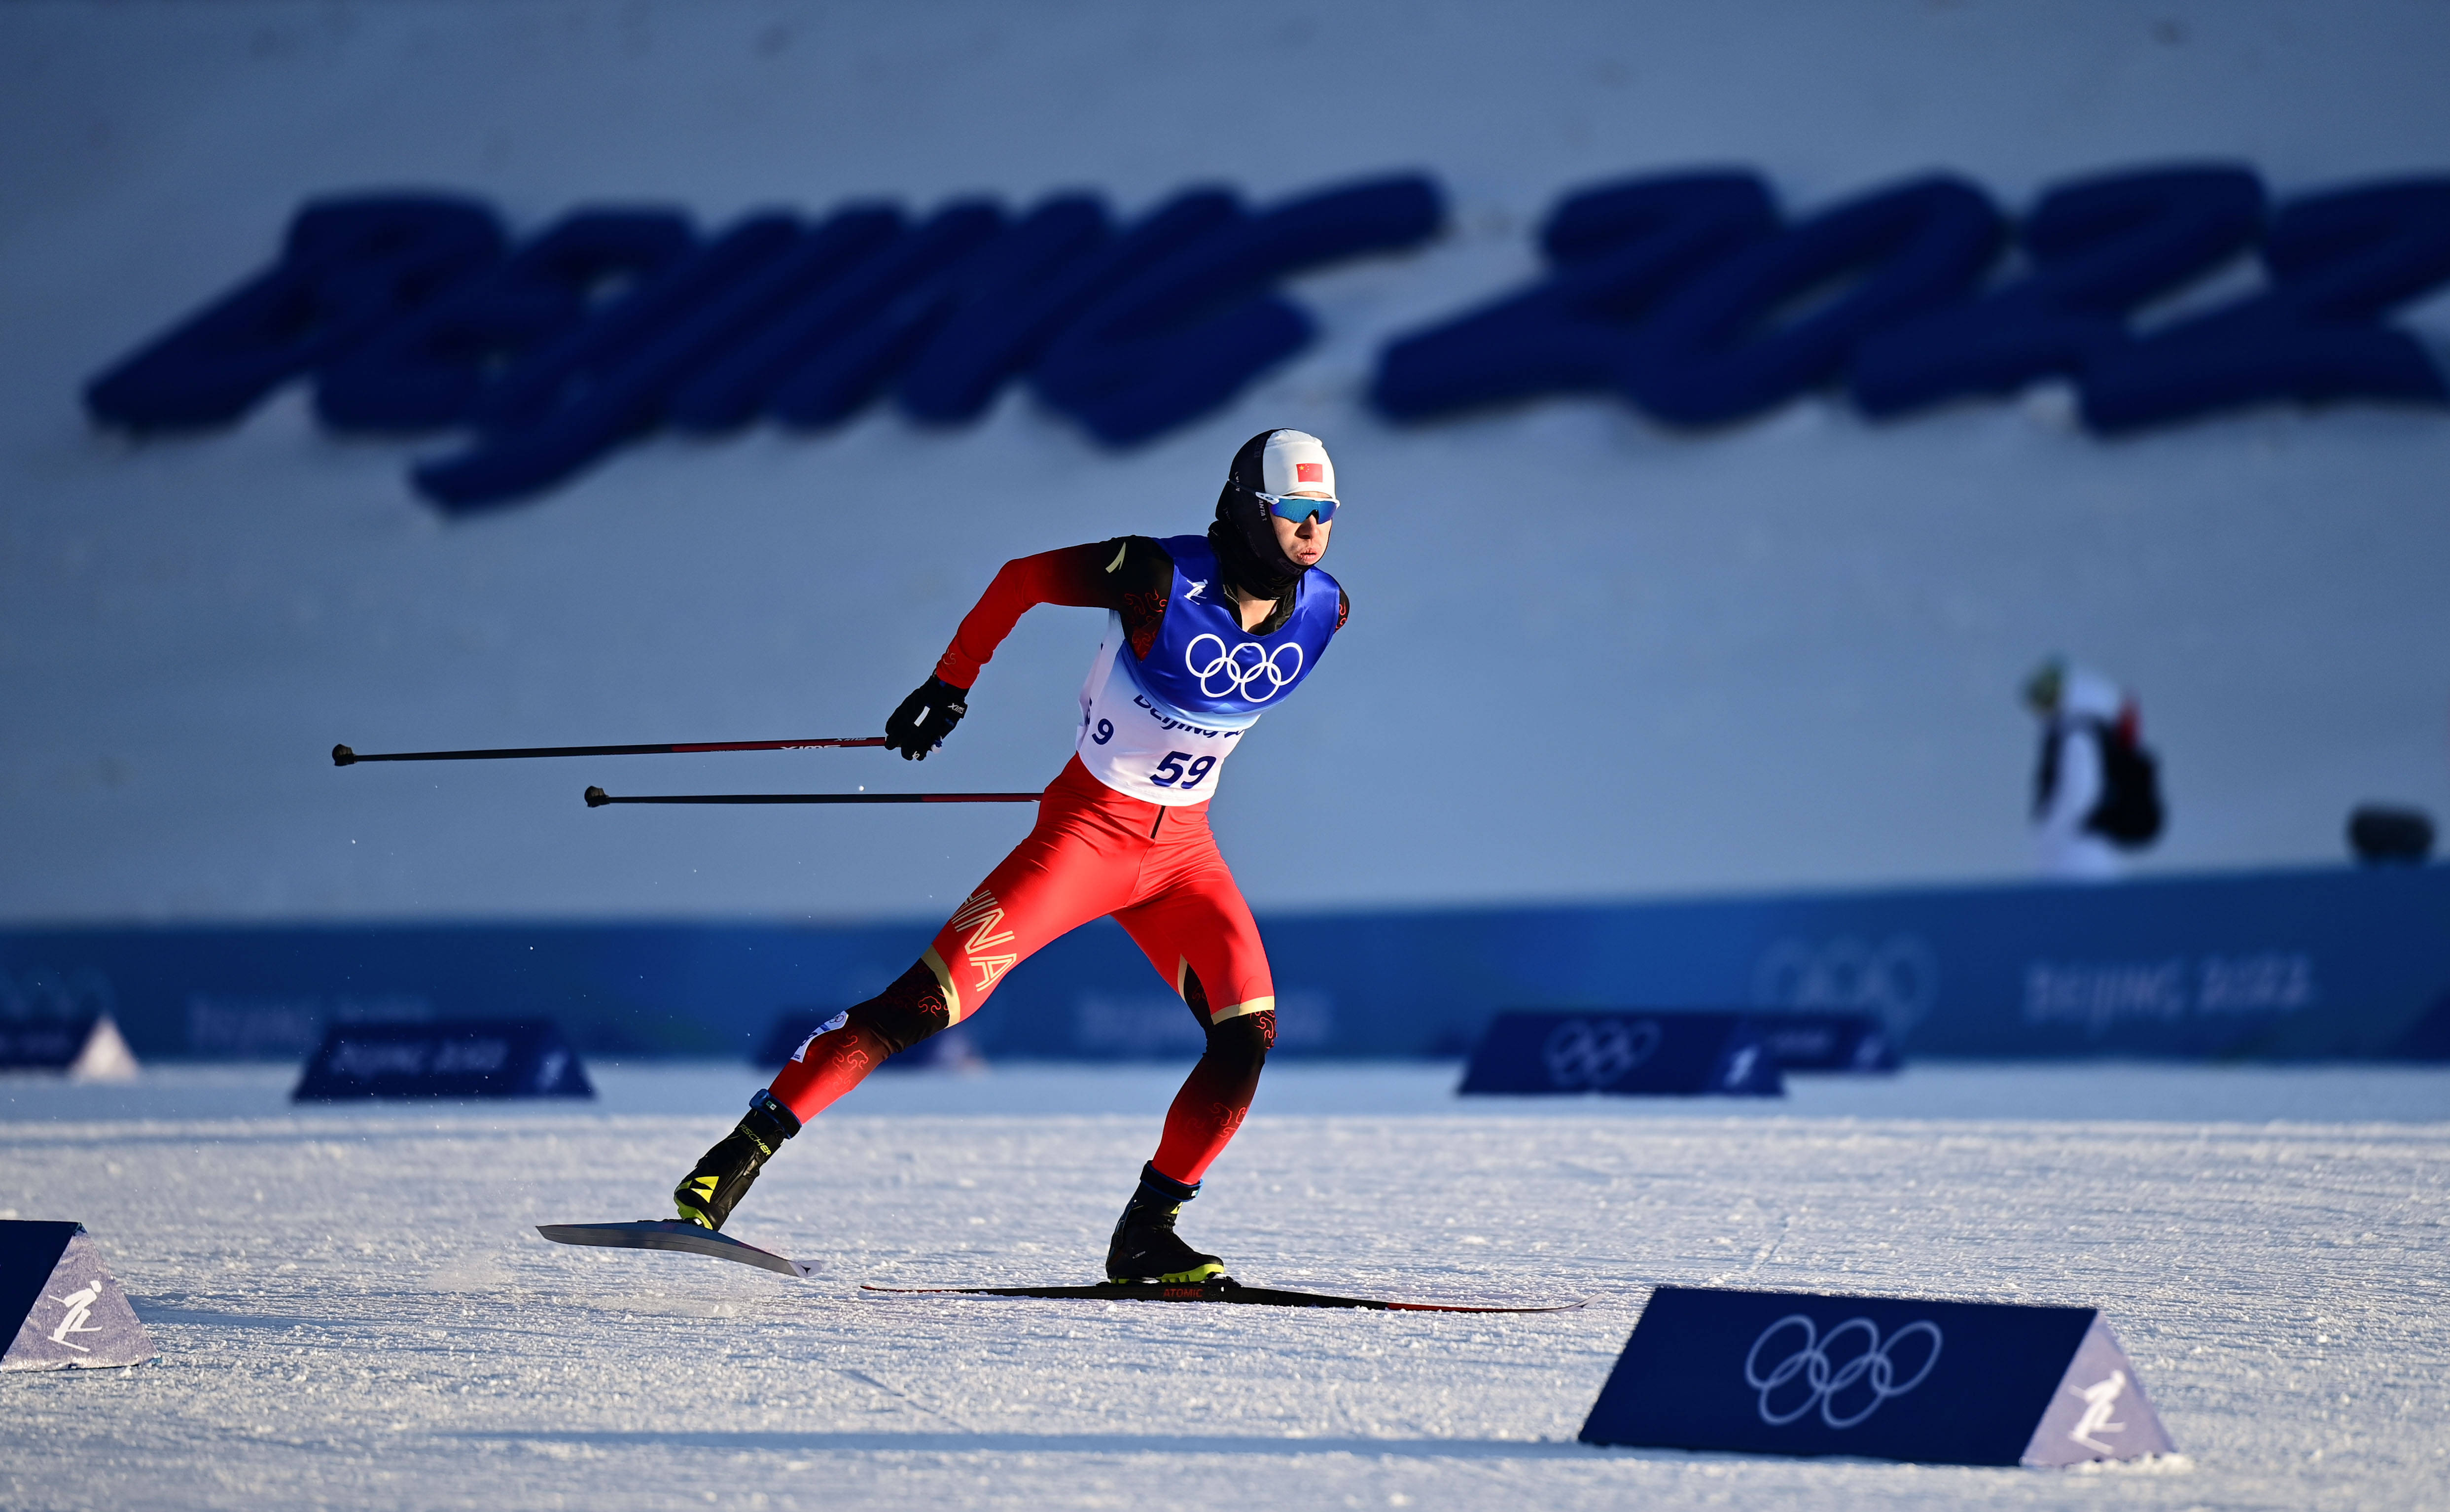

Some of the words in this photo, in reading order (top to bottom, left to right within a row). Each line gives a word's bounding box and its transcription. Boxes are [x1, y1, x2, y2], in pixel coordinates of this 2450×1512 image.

[1366, 160, 2450, 436] 2022
[1150, 751, 1216, 789] 59
[951, 889, 1017, 992] HINA
[739, 1124, 771, 1156] FISCHER
[1164, 1288, 1203, 1298] ATOMIC
